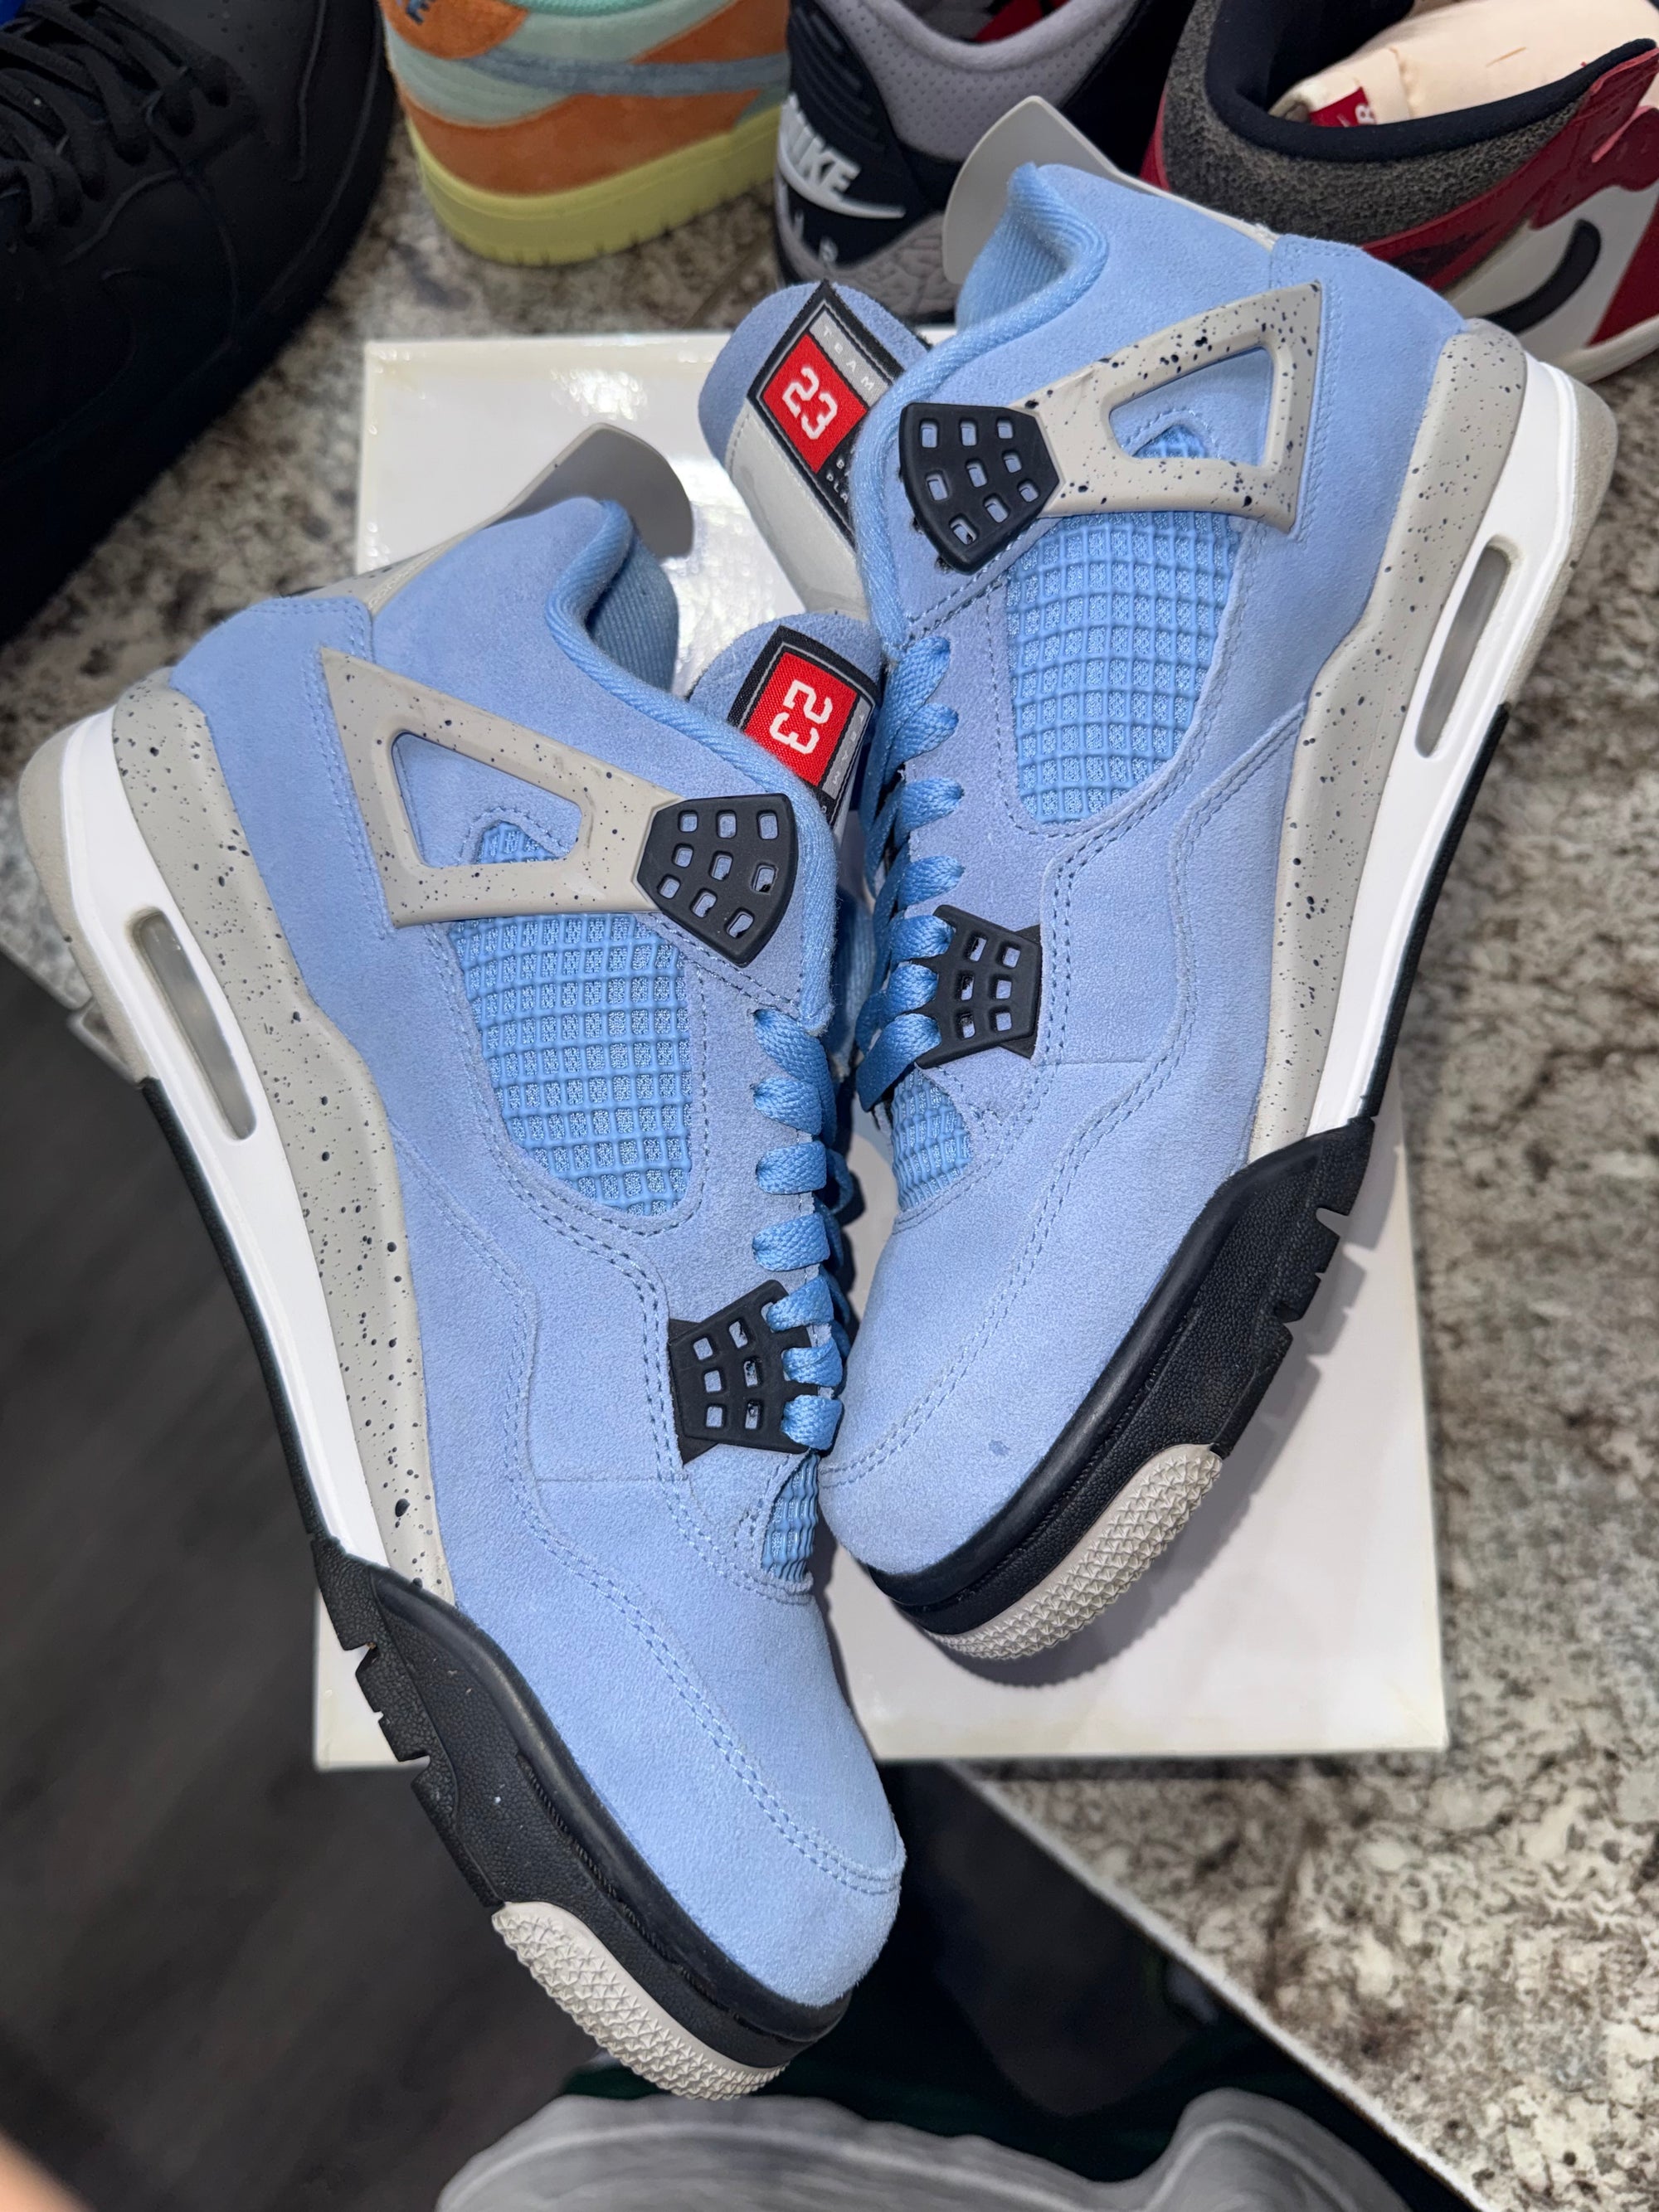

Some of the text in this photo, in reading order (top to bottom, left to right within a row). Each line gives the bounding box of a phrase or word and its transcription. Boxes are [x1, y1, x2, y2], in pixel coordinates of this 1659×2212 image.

[781, 92, 861, 201] NIKE
[824, 326, 874, 391] TEAM
[782, 367, 838, 440] 23
[769, 678, 833, 755] 23
[832, 714, 864, 785] TEAM
